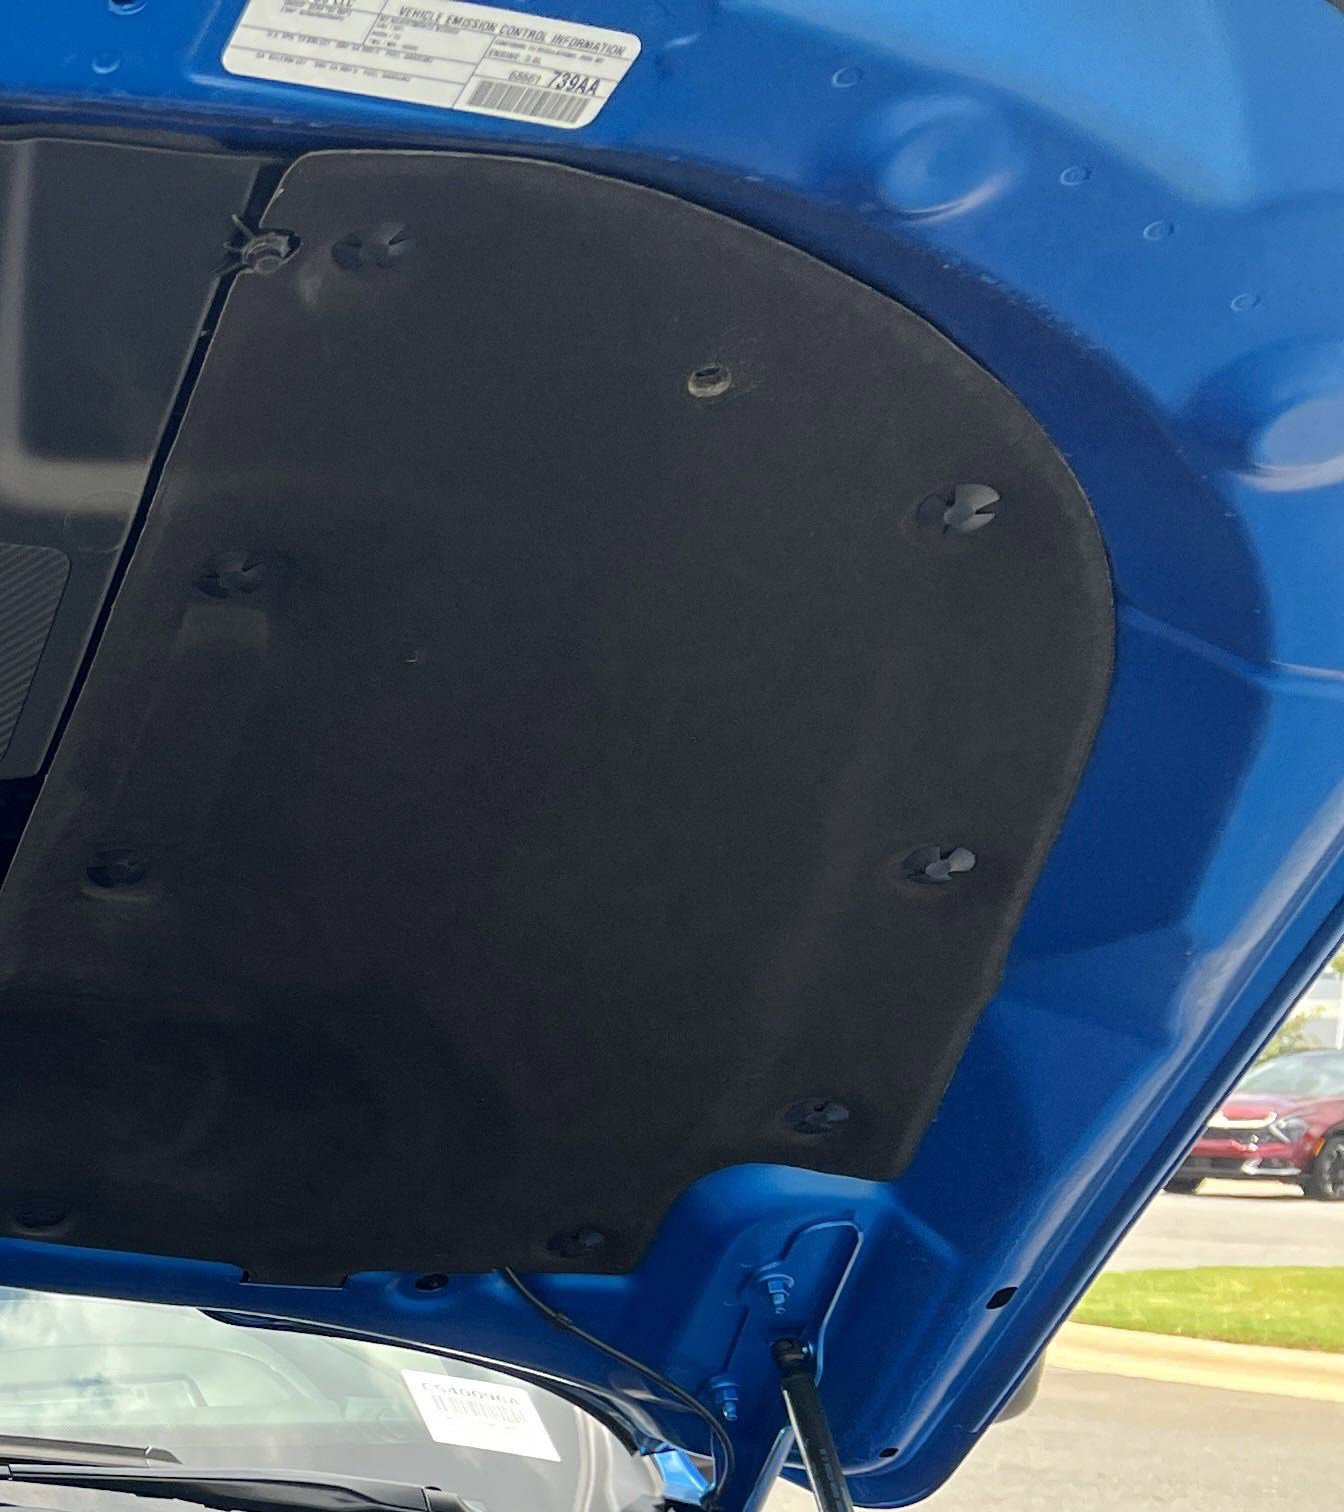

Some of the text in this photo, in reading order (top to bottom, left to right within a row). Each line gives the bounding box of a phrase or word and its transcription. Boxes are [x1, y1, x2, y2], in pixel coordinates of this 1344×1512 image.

[399, 6, 442, 24] VEHICLE
[445, 16, 496, 33] EMISSION
[499, 24, 547, 42] CONTROL
[550, 34, 627, 57] INFORMATION
[548, 70, 601, 96] 739AA
